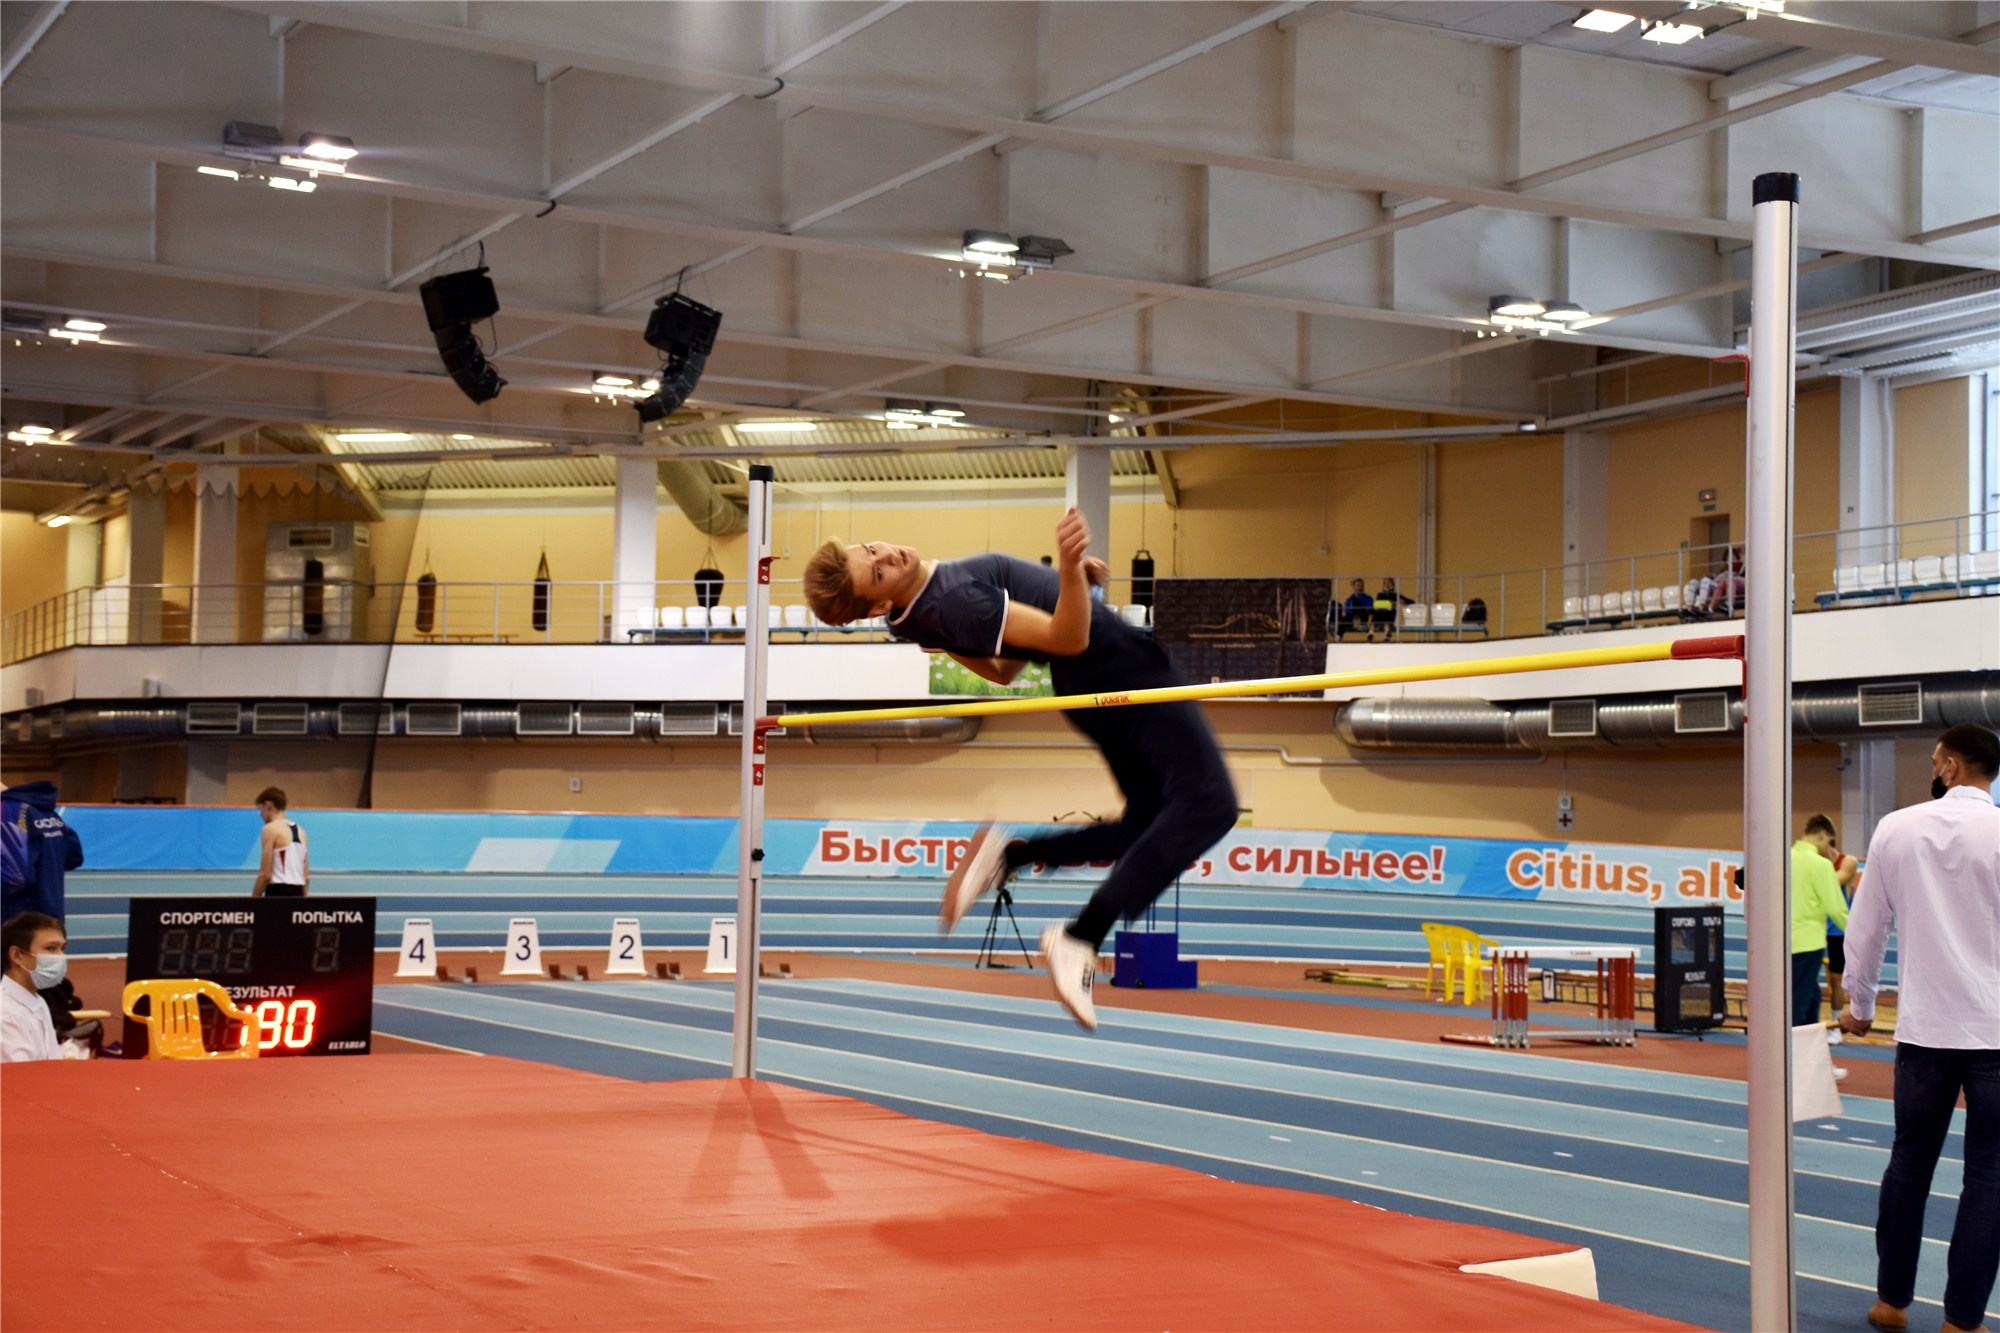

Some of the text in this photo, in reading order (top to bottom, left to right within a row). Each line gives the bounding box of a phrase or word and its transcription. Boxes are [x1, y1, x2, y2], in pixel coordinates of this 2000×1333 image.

[1228, 846, 1444, 882] сильнее!
[1508, 851, 1743, 901] Citius, alt
[159, 911, 364, 925] СПОРТСМЕН ПОПЫТКА
[408, 937, 426, 963] 4
[515, 935, 532, 961] 3
[618, 935, 635, 960] 2
[720, 935, 729, 959] 1
[224, 985, 296, 999] ЕЗУЛЬТАТ
